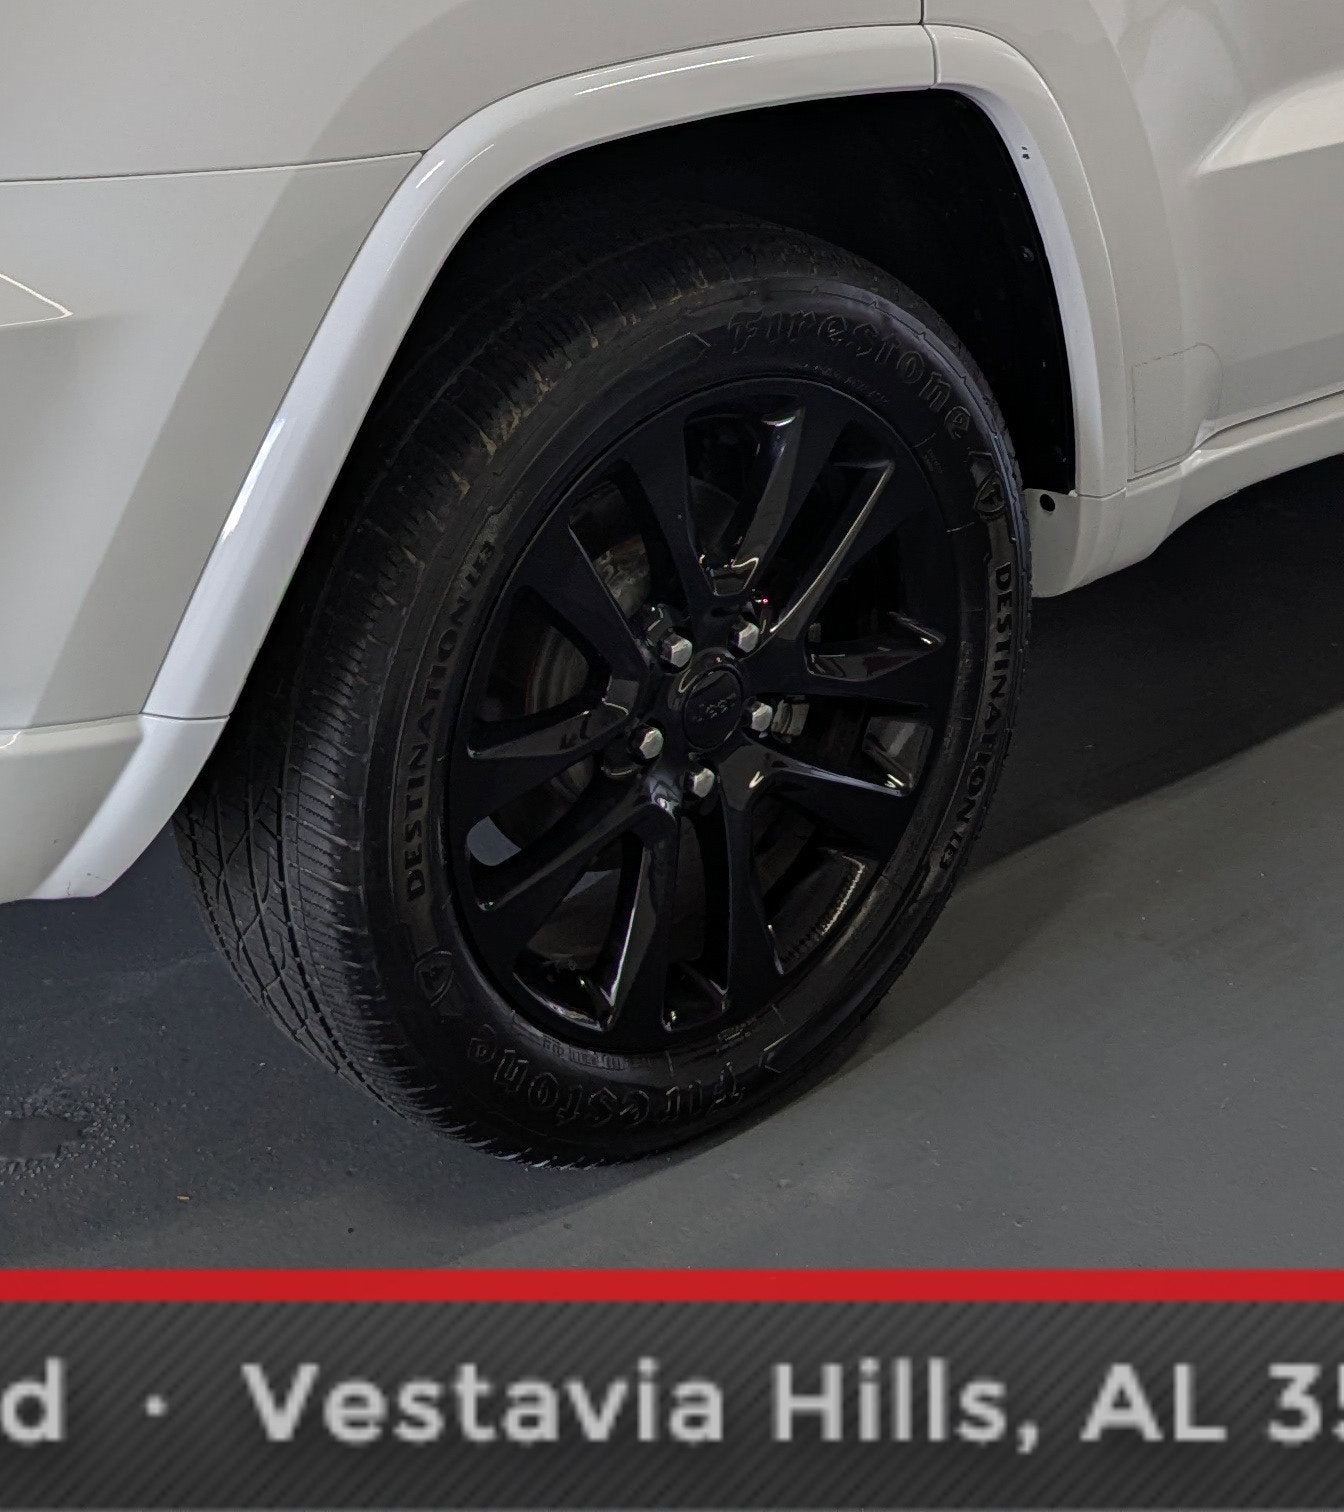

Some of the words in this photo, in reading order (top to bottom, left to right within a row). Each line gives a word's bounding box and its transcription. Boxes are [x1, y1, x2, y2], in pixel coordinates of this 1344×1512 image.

[727, 309, 974, 441] Firestone
[404, 595, 472, 903] DESTINATION
[956, 560, 1015, 825] DESTINATION
[465, 1024, 748, 1129] Firestone
